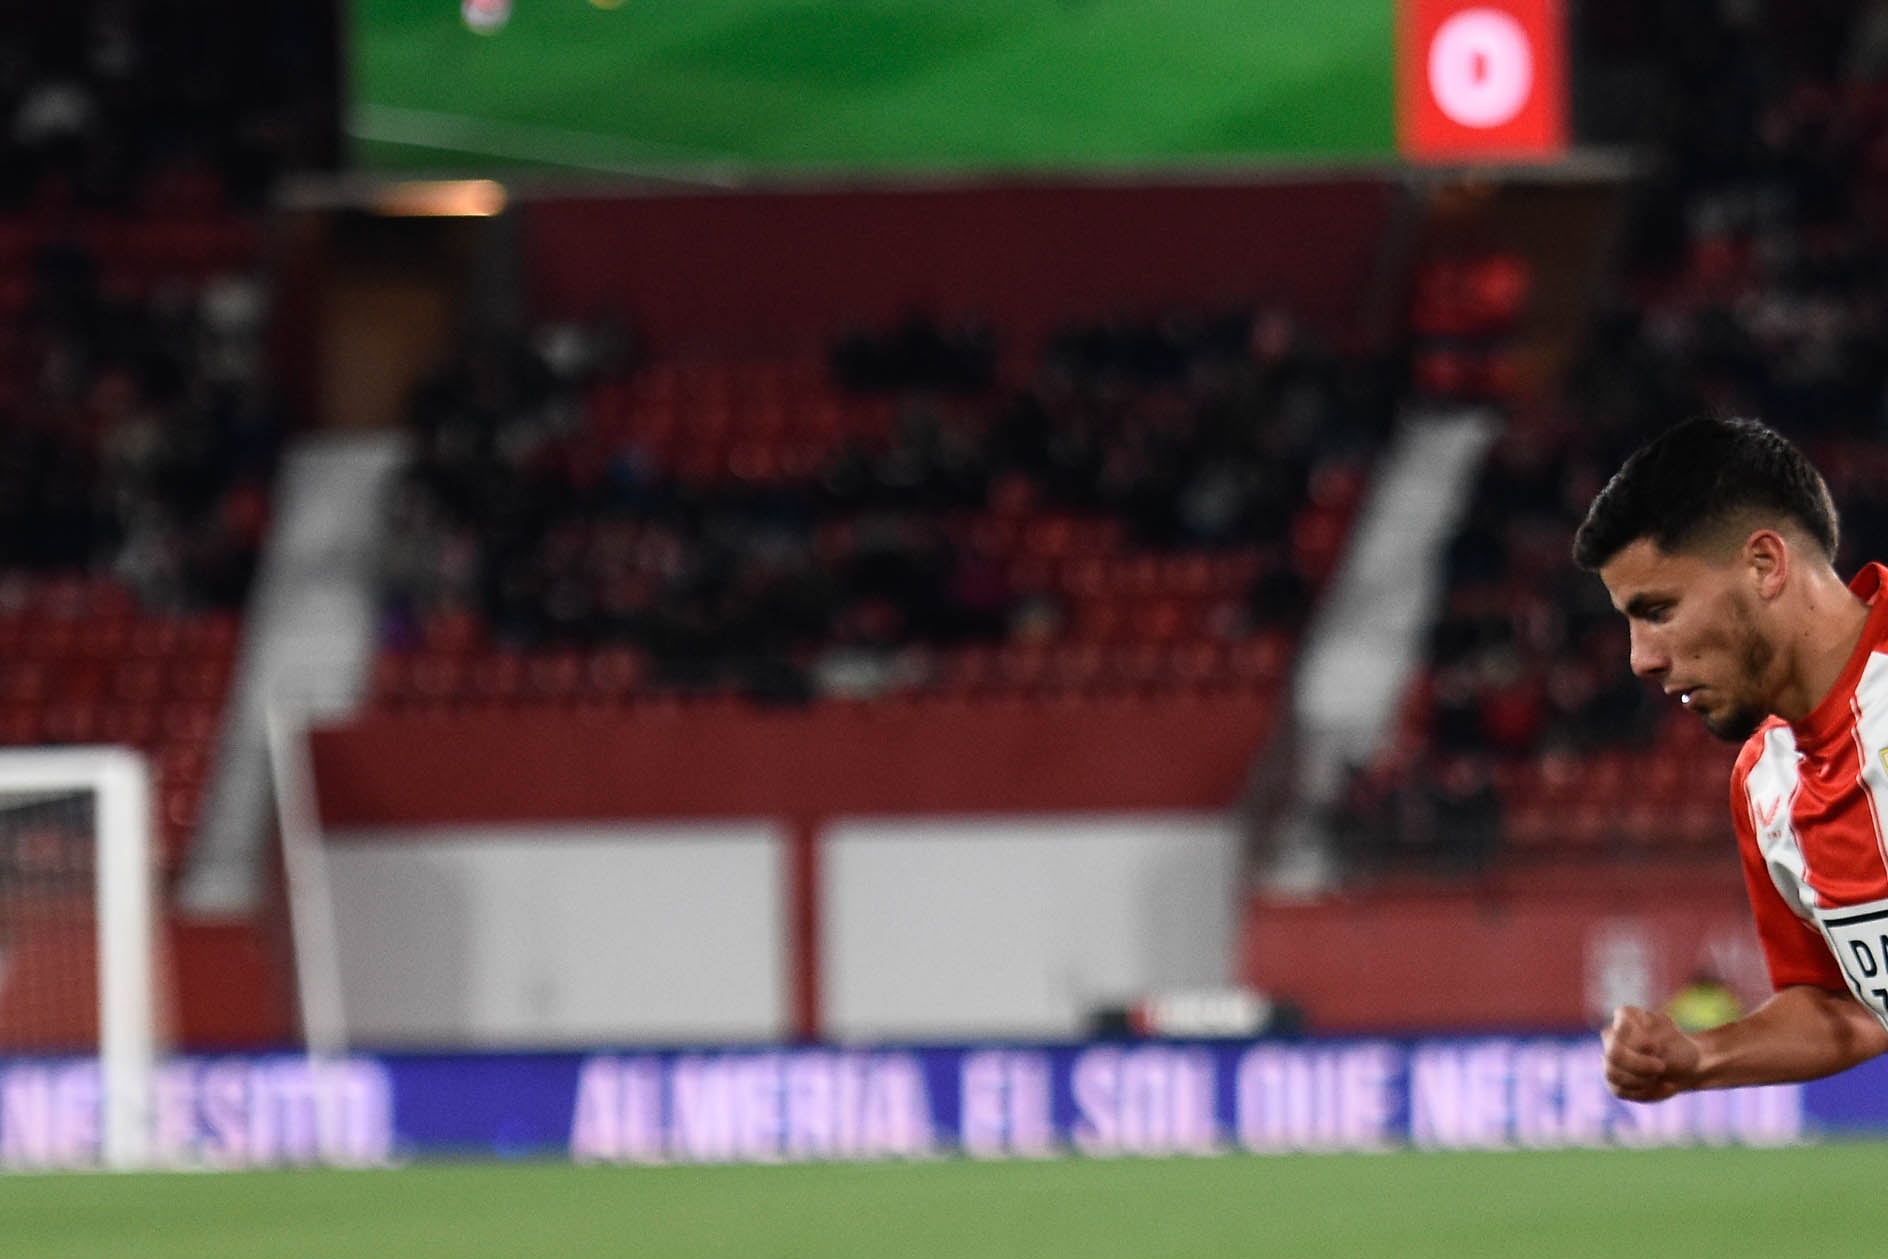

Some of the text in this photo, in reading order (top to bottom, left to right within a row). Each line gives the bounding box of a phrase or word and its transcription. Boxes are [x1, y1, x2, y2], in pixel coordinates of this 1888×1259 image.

[1427, 7, 1536, 129] 0
[2, 1056, 395, 1169] NEESITO
[960, 1046, 1053, 1157] EL
[1071, 1044, 1222, 1156] SOL
